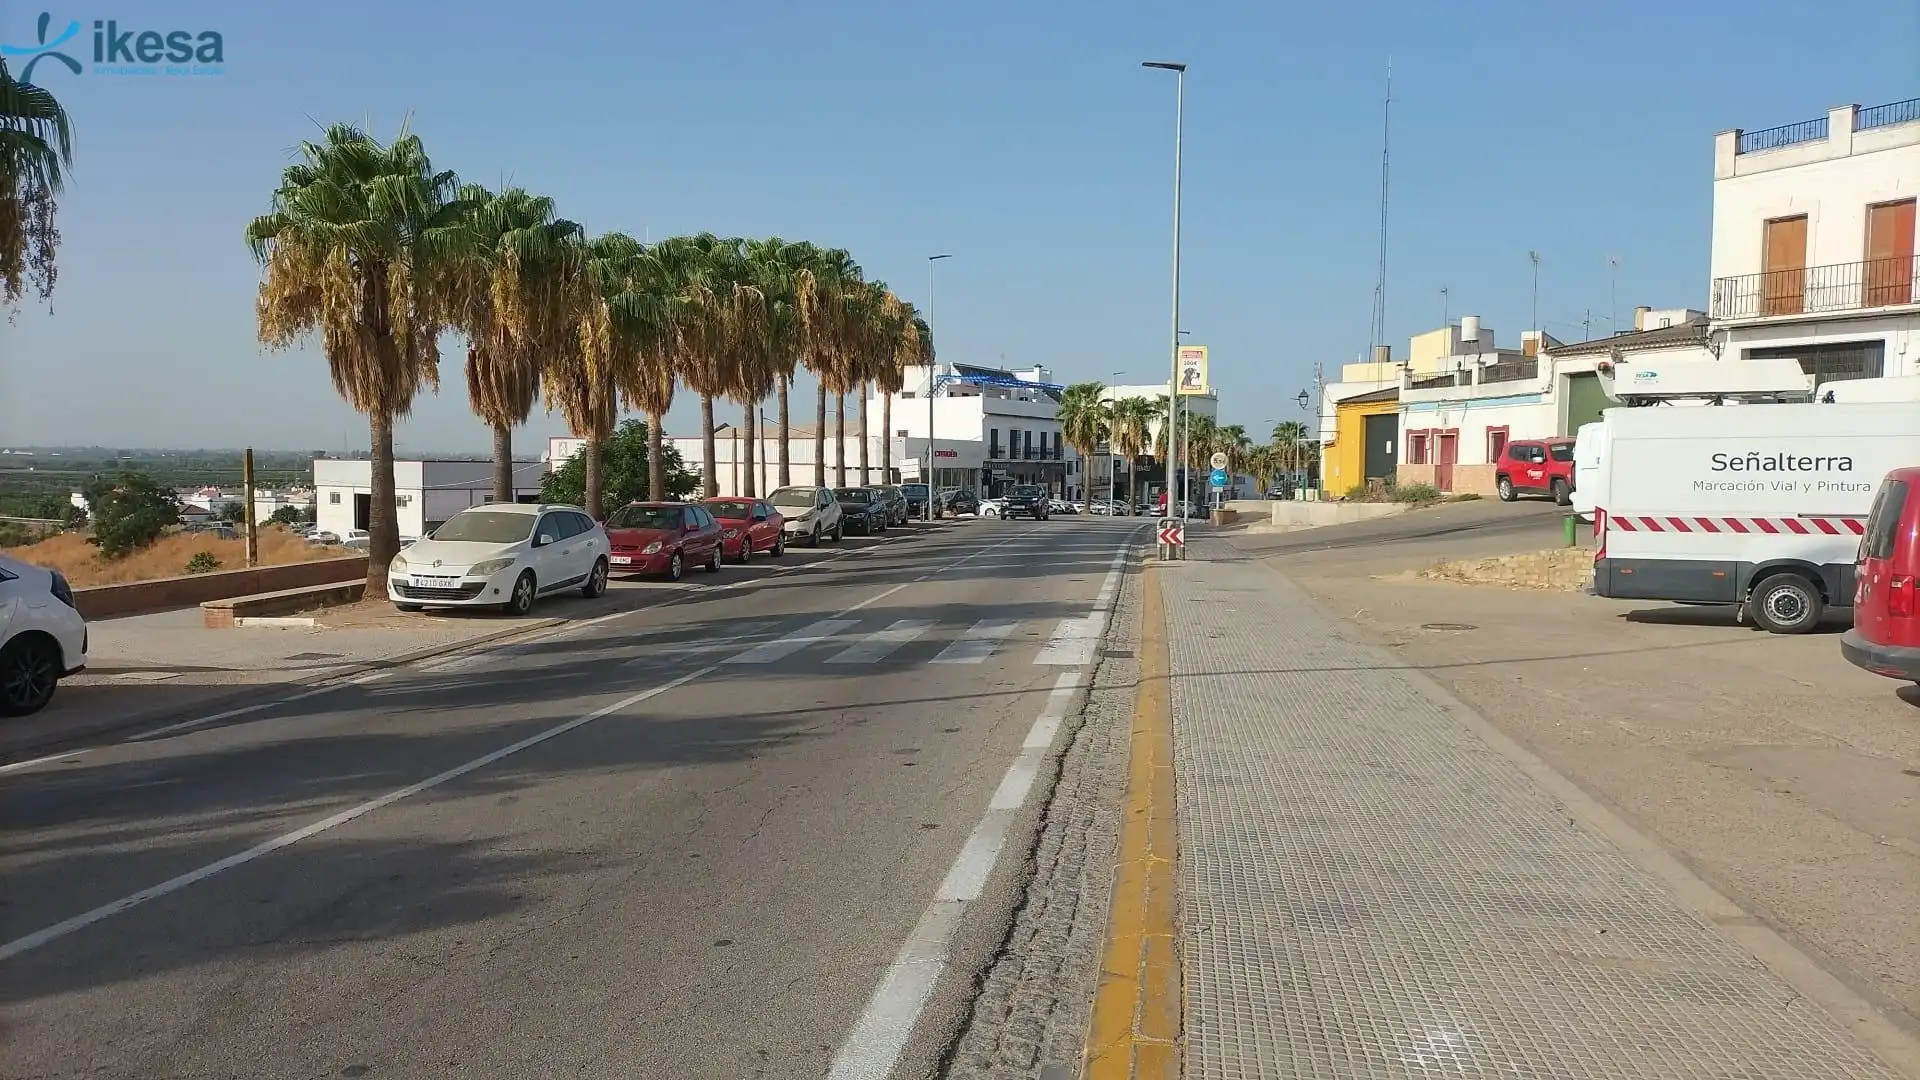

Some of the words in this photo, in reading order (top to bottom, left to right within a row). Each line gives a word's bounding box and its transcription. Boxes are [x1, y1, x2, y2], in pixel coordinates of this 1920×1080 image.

[1711, 452, 1853, 472] Señalterra
[1693, 480, 1765, 491] Marcación
[1771, 480, 1797, 491] Vial
[1803, 483, 1811, 492] y
[1817, 480, 1871, 492] Pintura
